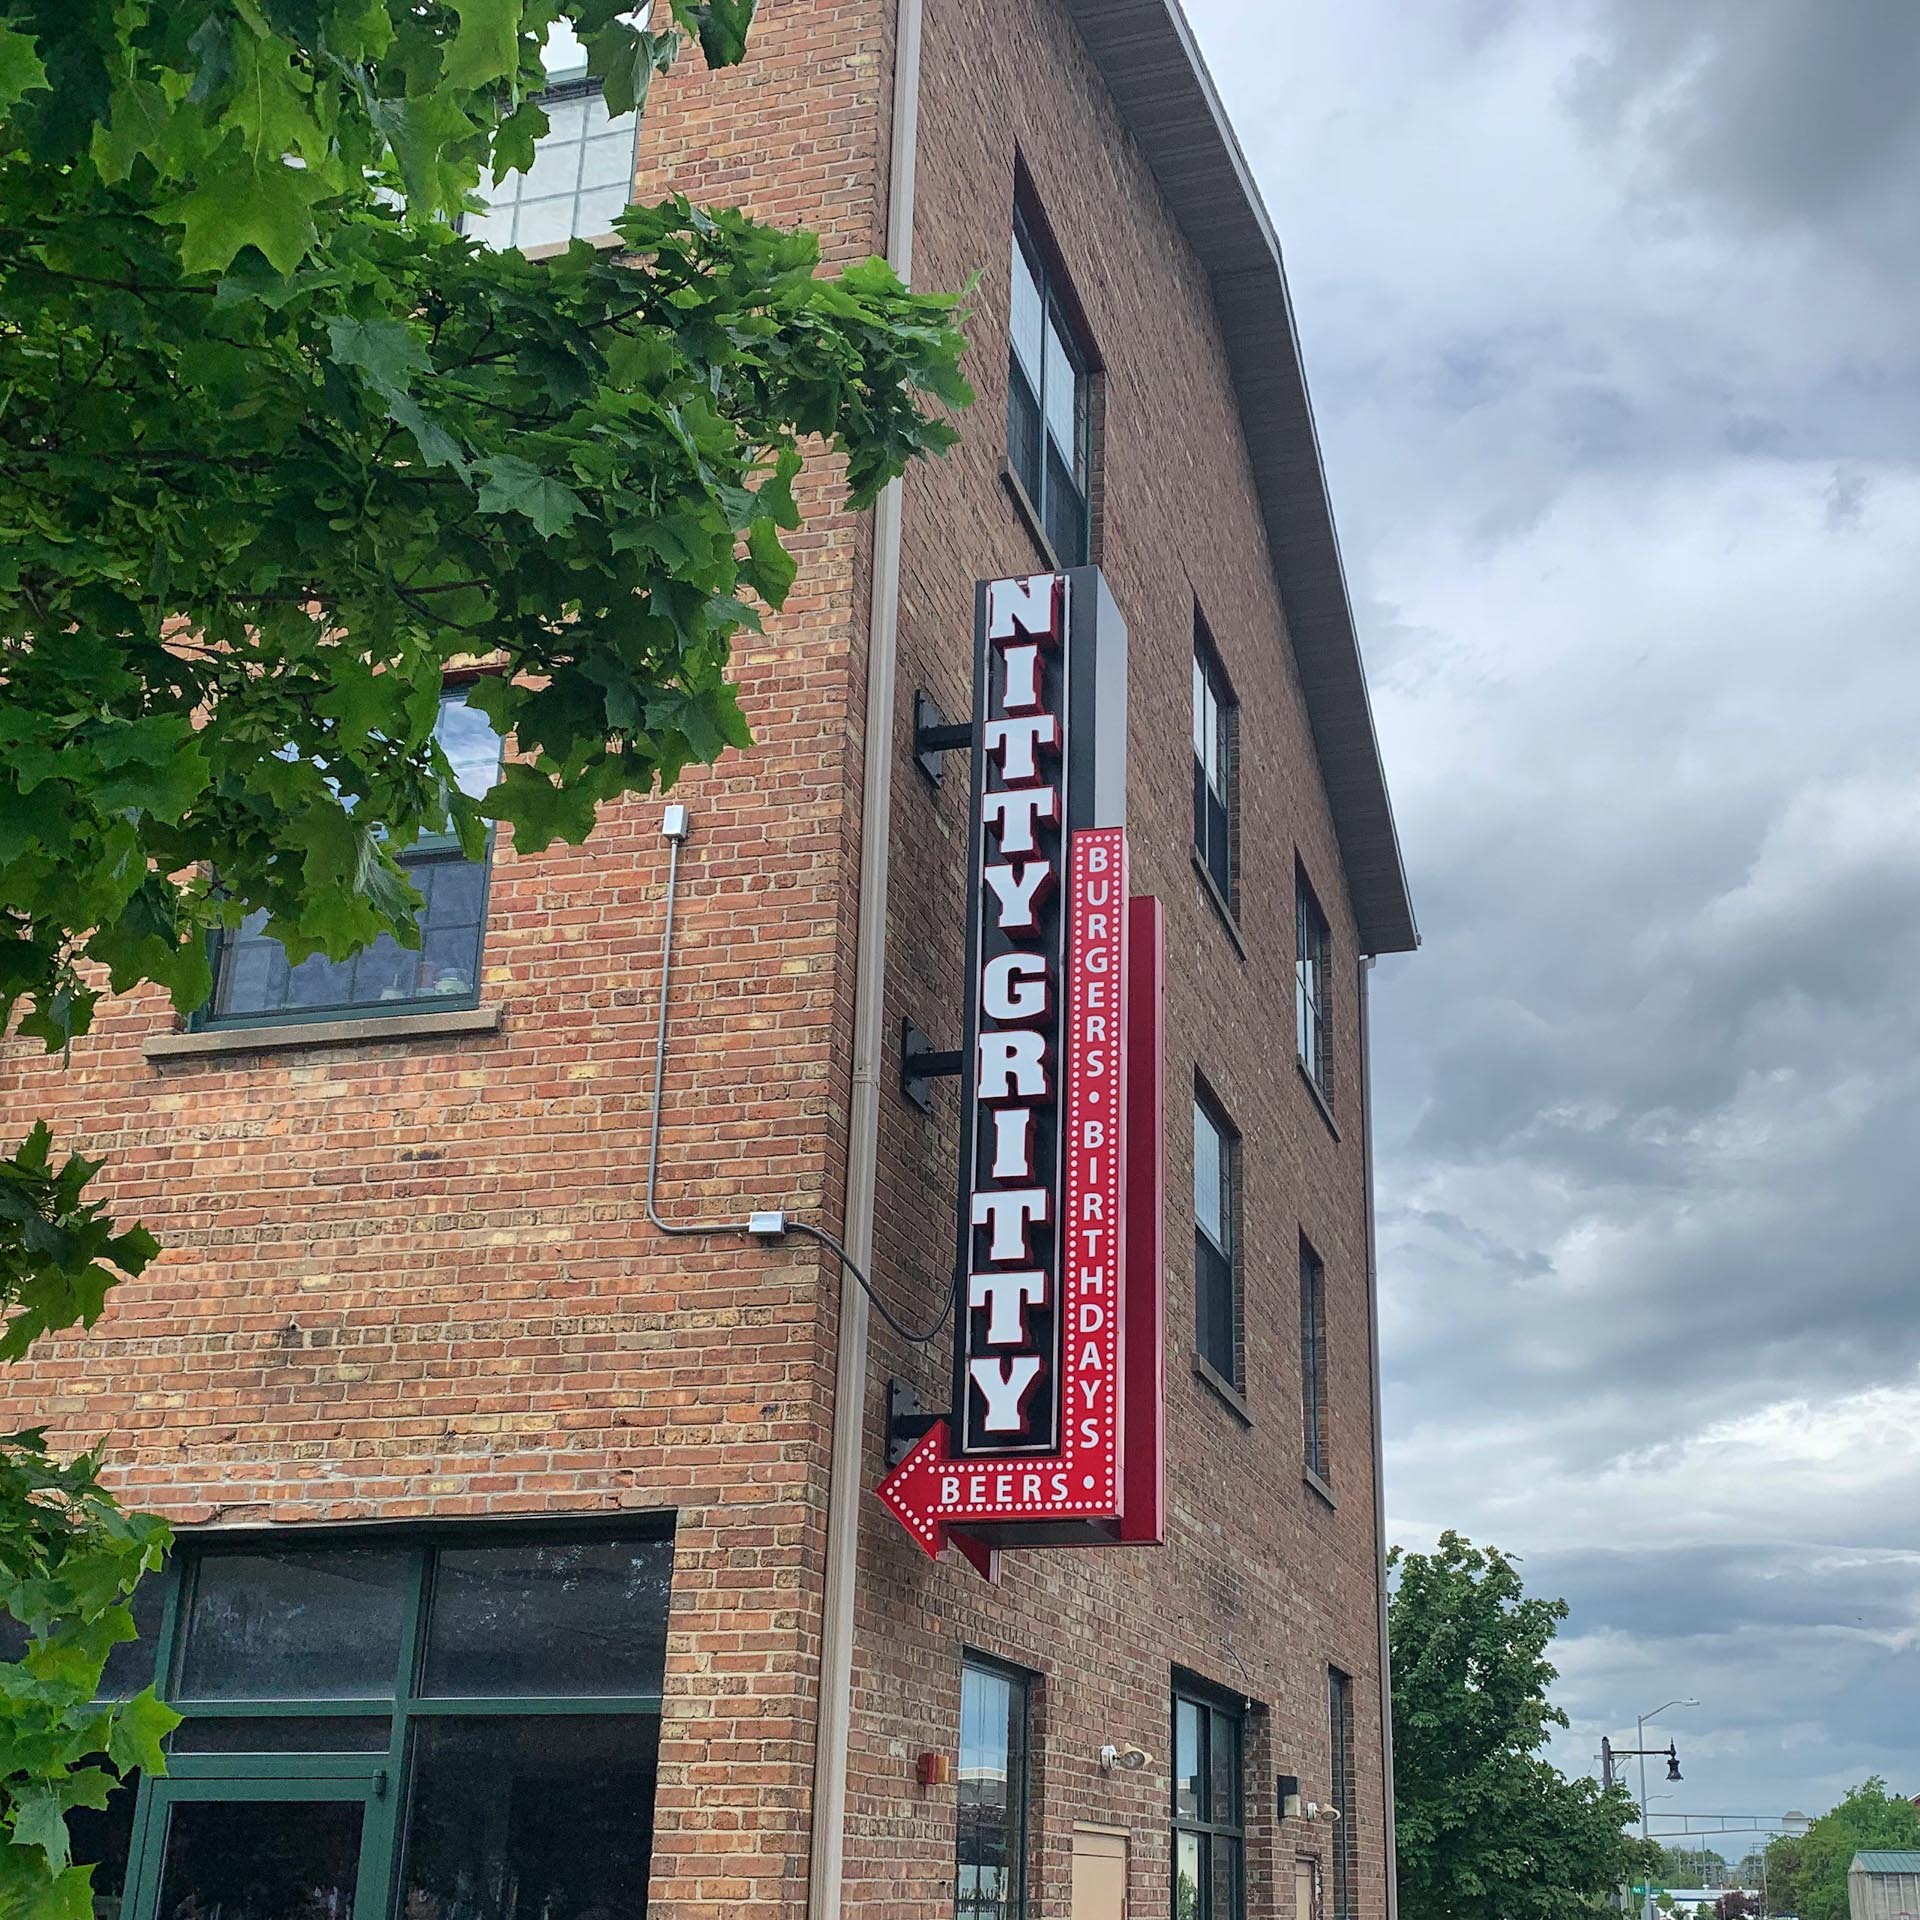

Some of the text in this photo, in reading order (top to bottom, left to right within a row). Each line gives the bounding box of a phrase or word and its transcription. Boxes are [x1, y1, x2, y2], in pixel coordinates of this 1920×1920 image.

[968, 573, 1057, 1432] NITTY GRITTY
[1079, 848, 1108, 1449] BURGERS BIRTHDAYS
[941, 1474, 1069, 1504] BEERS
